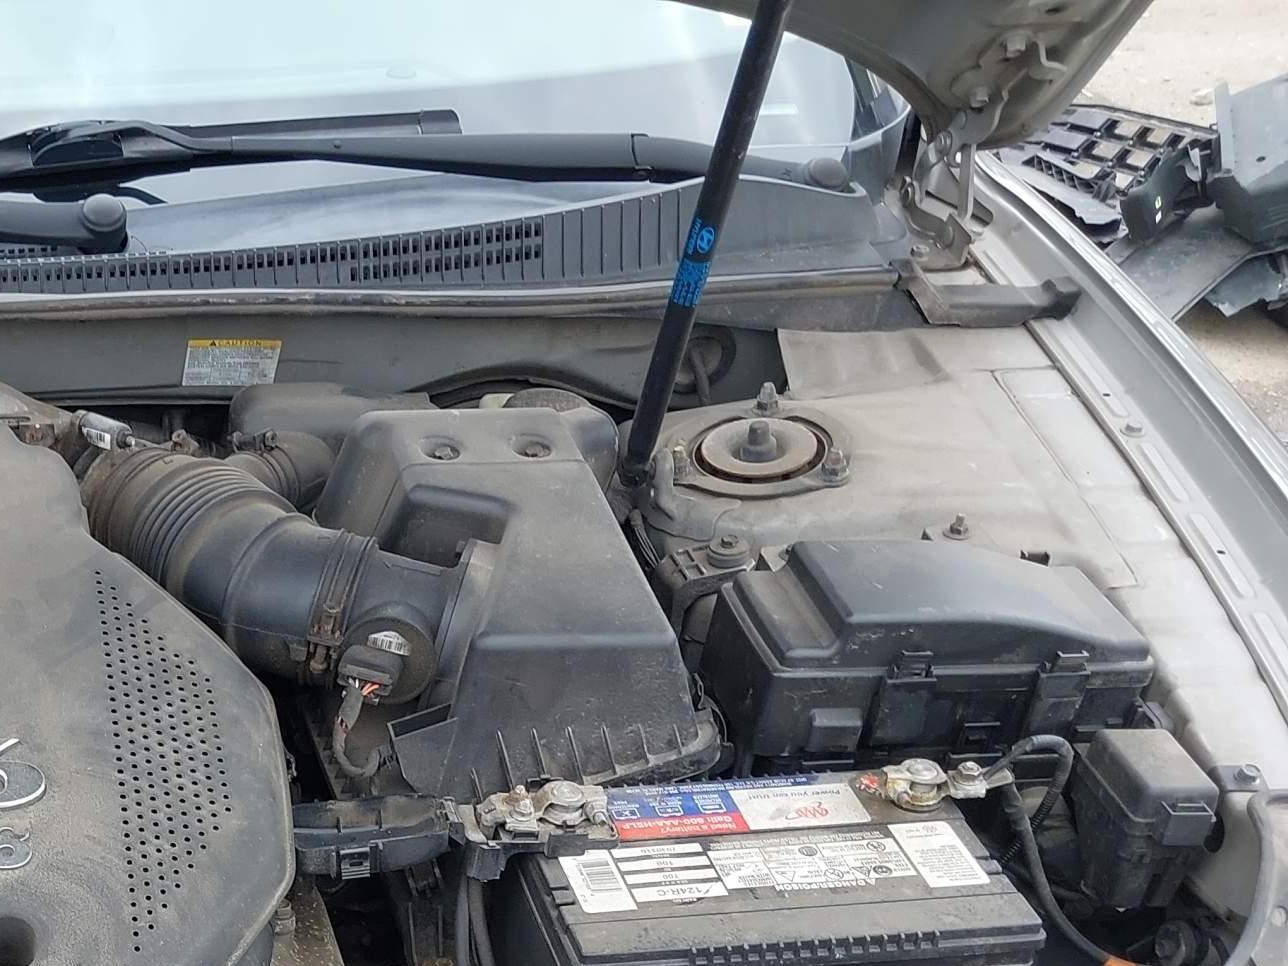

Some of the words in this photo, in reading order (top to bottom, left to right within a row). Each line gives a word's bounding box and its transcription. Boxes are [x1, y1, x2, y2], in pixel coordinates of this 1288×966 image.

[621, 817, 705, 830] 800-AAA-HELP
[706, 815, 733, 824] Call:
[709, 822, 737, 830] Need
[774, 878, 866, 891] DANGER/POISON
